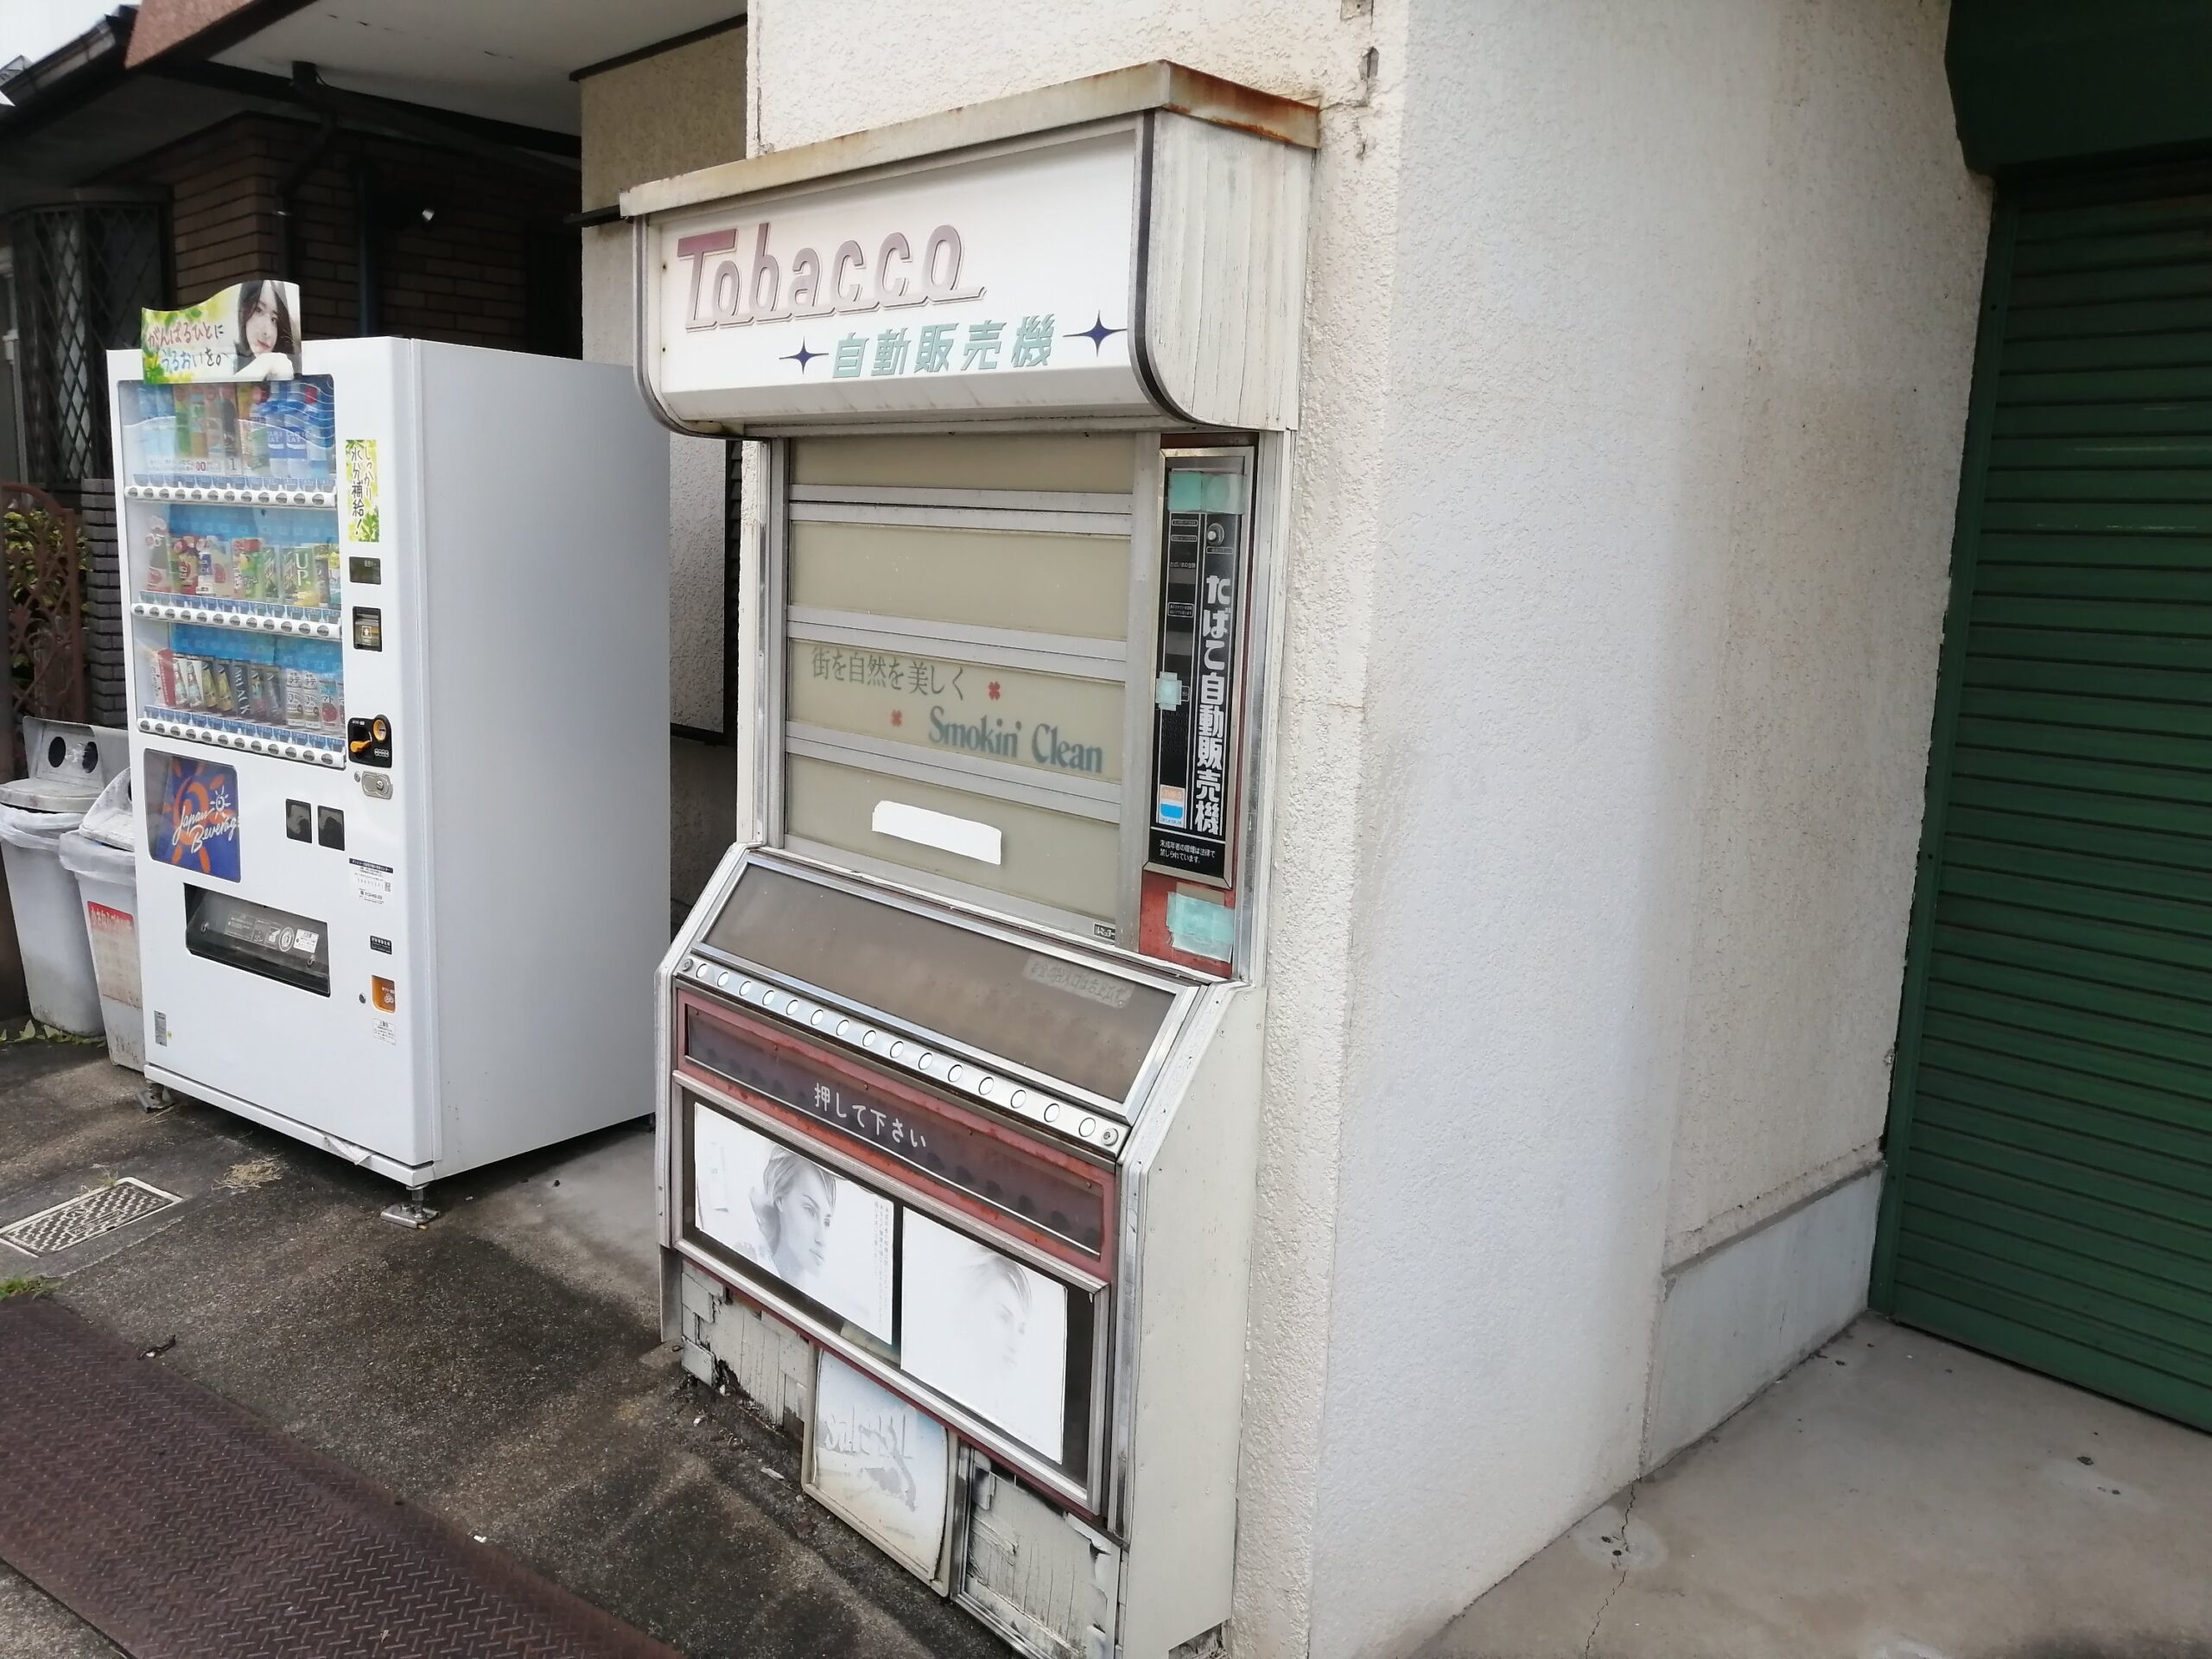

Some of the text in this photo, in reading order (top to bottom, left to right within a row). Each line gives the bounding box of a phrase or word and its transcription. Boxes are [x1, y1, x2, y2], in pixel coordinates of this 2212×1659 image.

[677, 221, 987, 333] Tobacco
[147, 321, 225, 347] がんばるひとに
[831, 313, 1058, 380] 自動販売機
[364, 446, 374, 501] しっかり
[810, 645, 964, 702] 街を自然を美しく
[1194, 575, 1231, 836] たばこ自動販売機
[928, 704, 1103, 774] Smokin' Clean
[814, 1082, 927, 1148] 押して下さい
